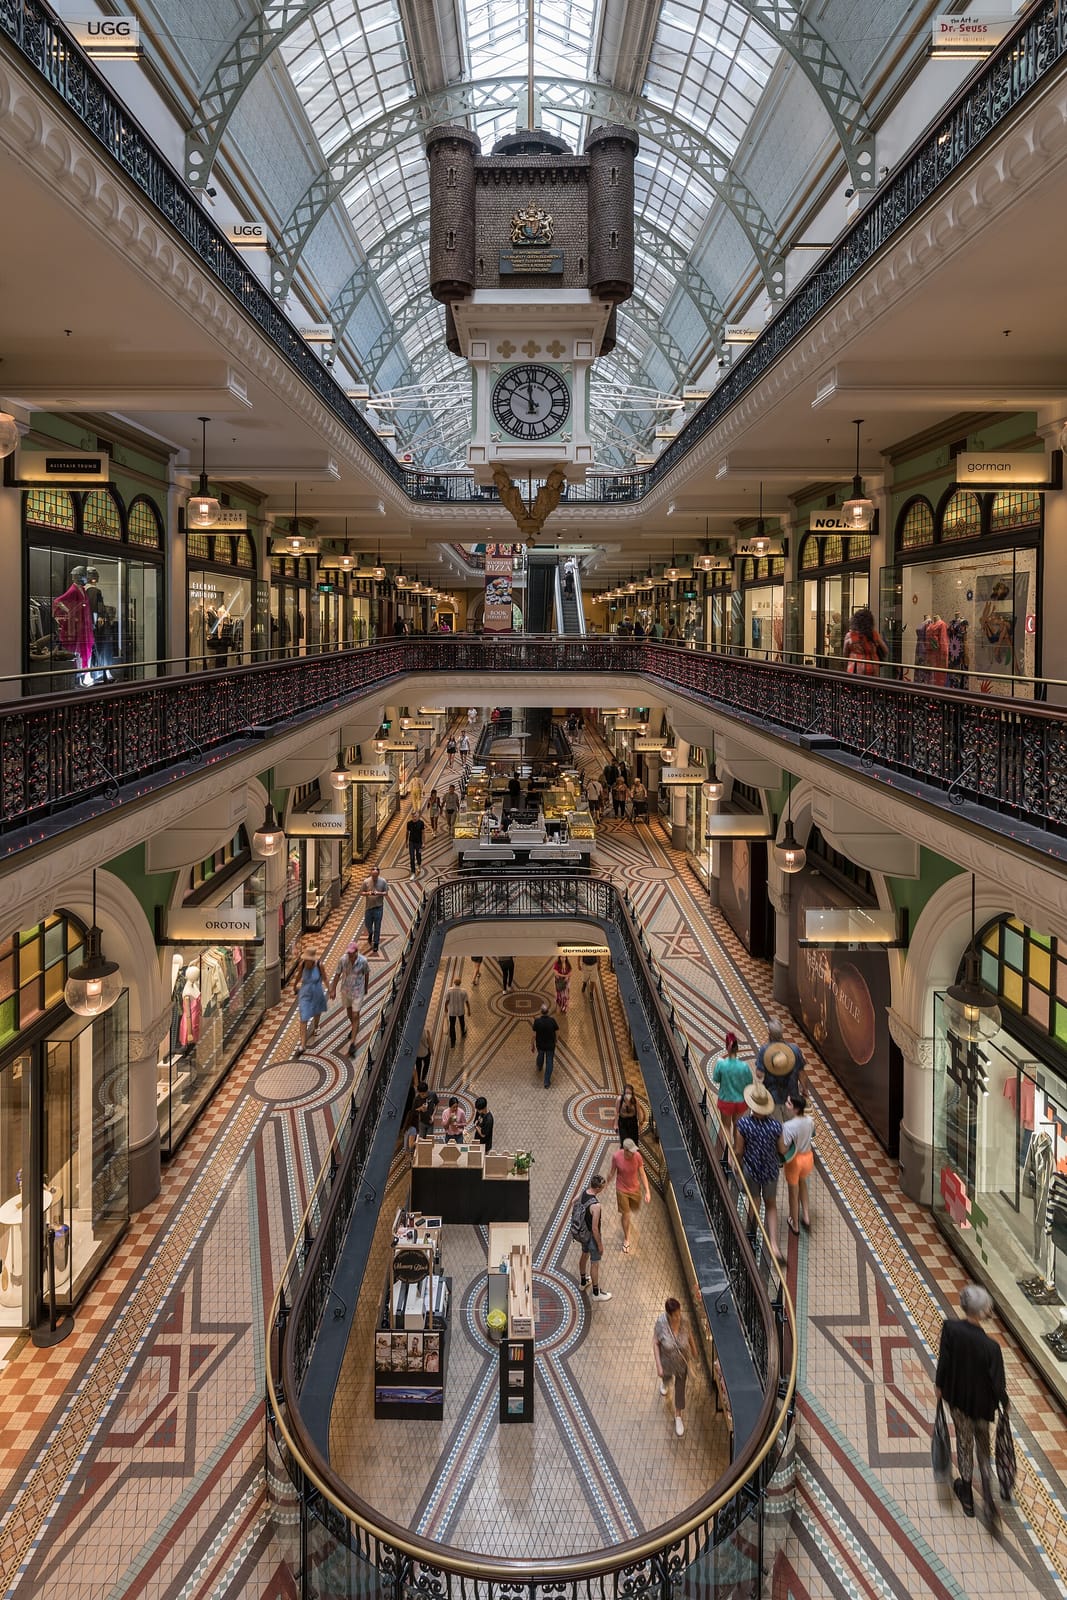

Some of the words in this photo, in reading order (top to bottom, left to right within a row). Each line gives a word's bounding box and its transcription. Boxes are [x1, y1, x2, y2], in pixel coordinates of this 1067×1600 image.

[88, 22, 130, 36] UGG
[940, 24, 956, 32] Dr.
[960, 24, 988, 32] Seuss
[233, 226, 262, 236] UGG
[967, 463, 1012, 472] gorman
[205, 921, 250, 930] OROTON
[840, 988, 861, 1024] RULE
